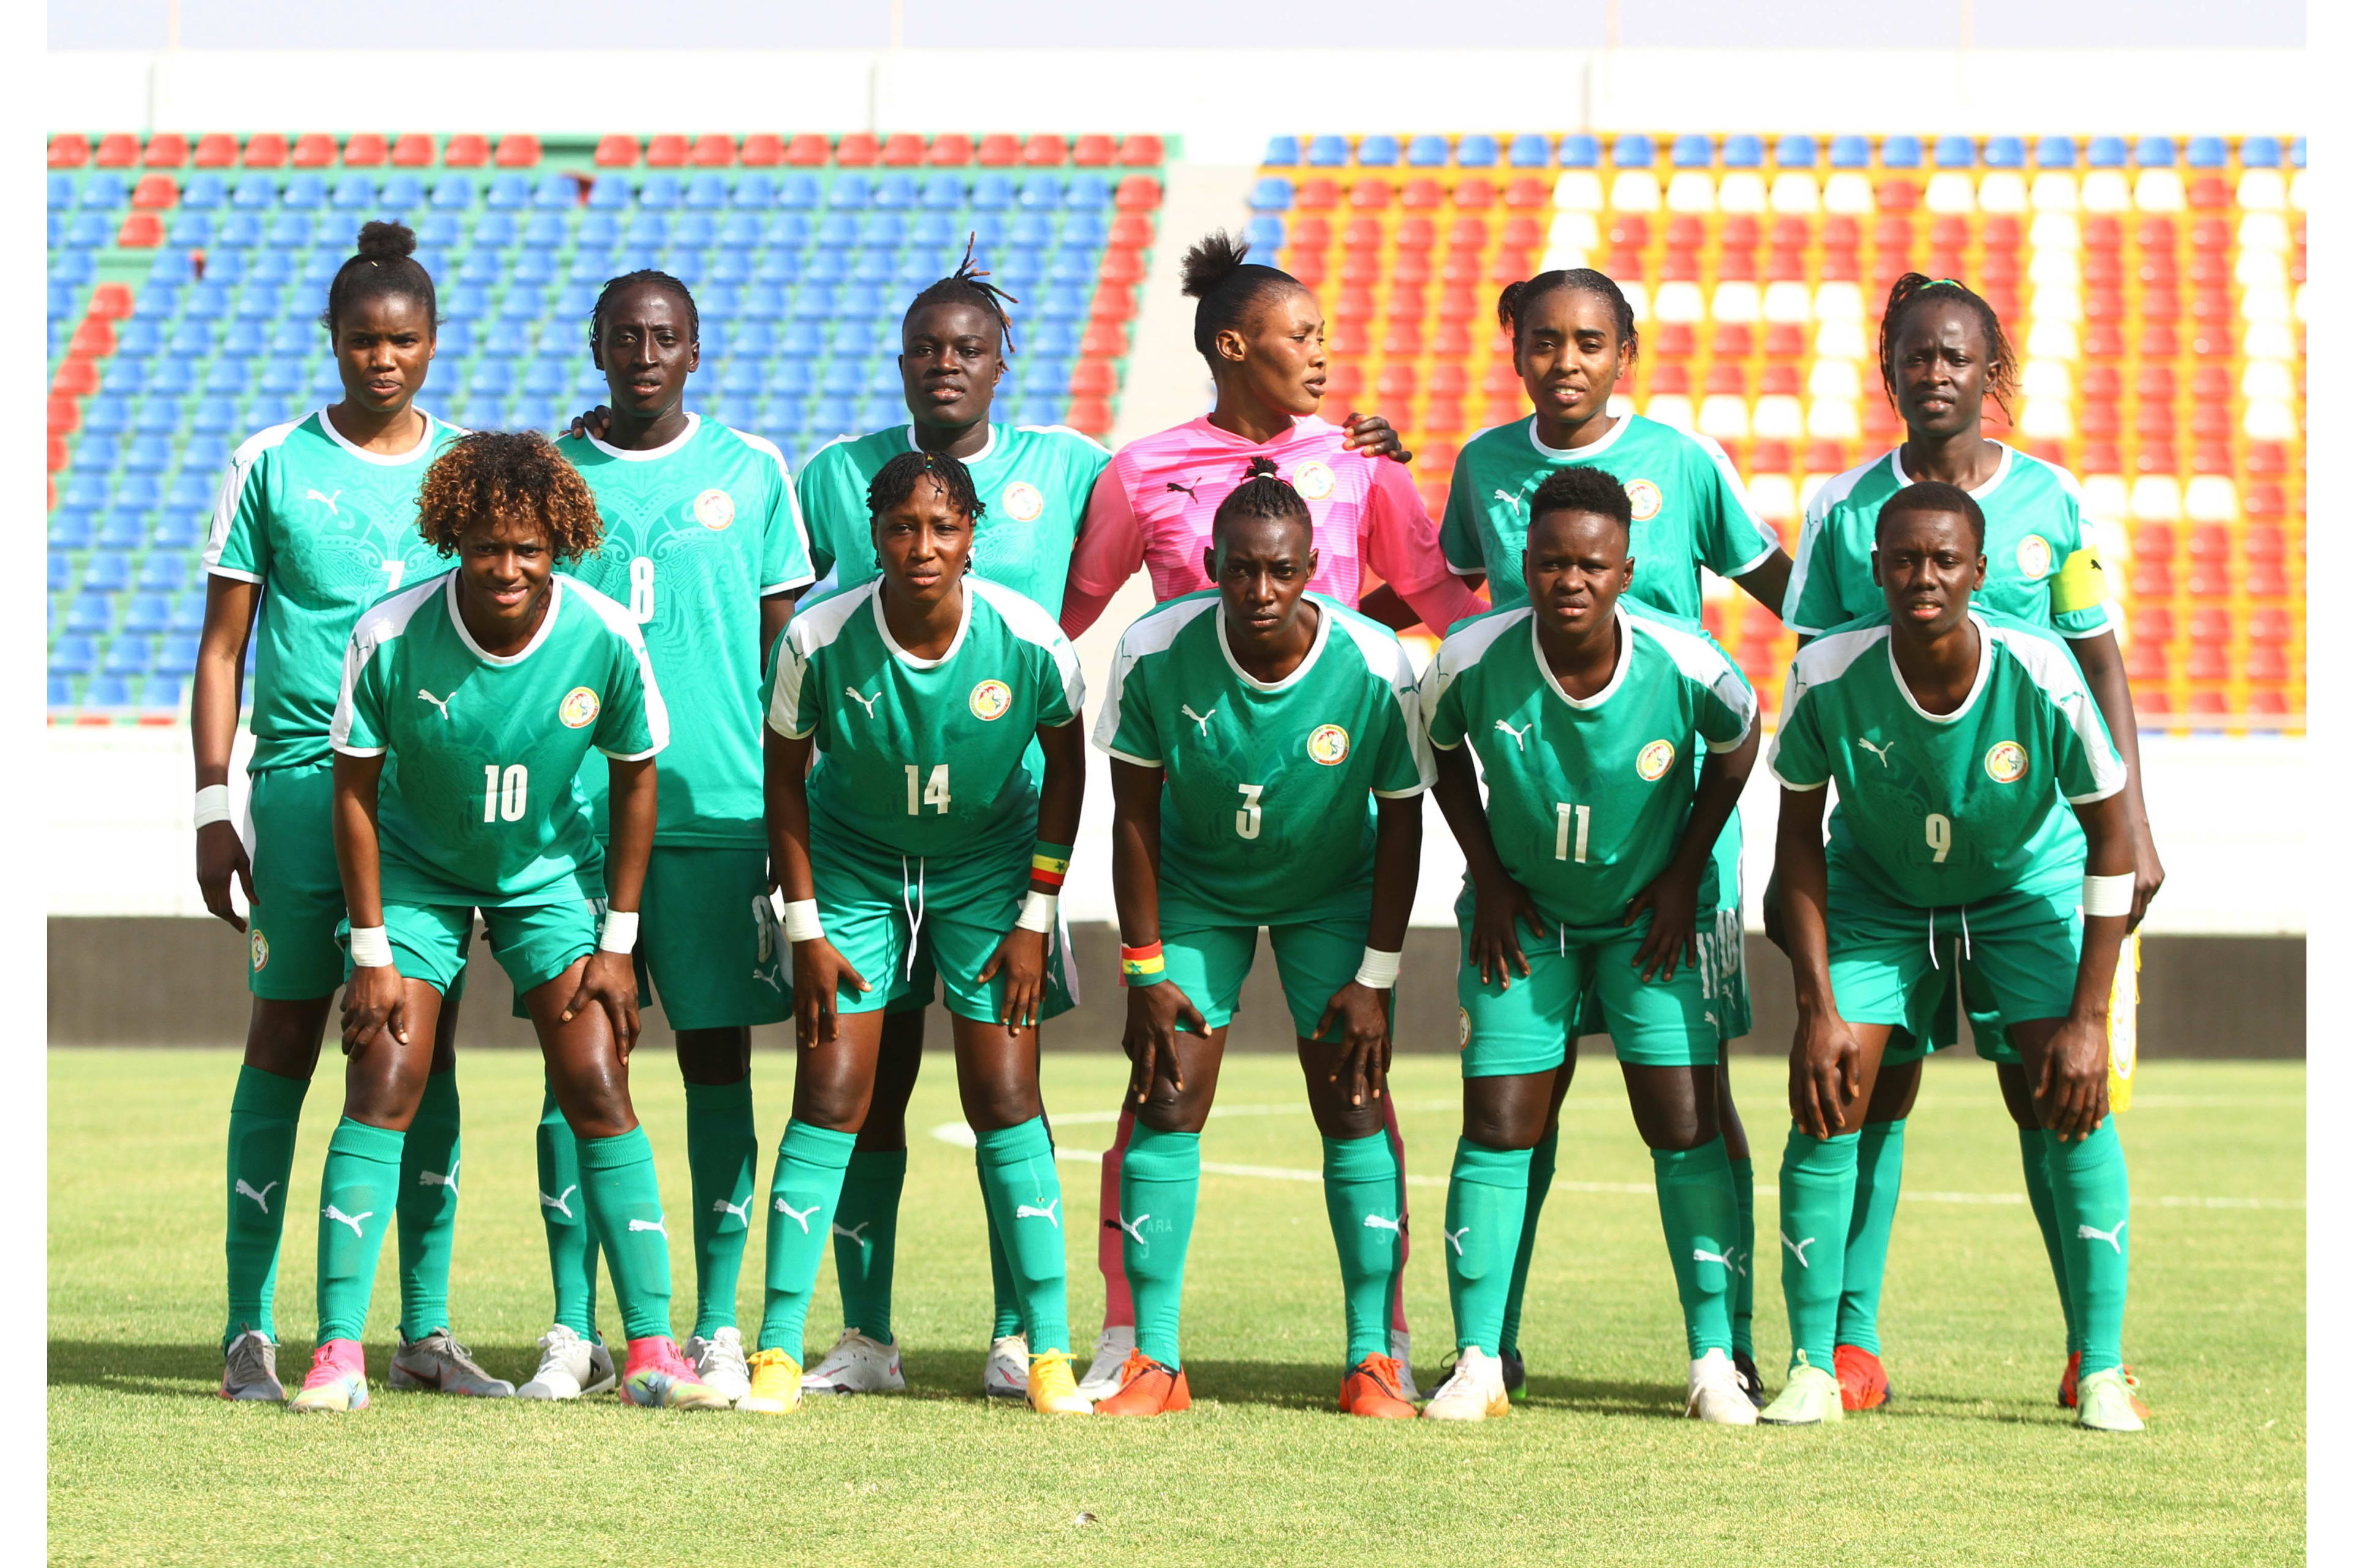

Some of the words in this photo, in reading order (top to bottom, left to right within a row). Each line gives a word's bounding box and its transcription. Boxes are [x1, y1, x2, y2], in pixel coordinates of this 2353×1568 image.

[381, 559, 406, 593] 7
[630, 556, 654, 624] 8
[484, 764, 528, 823] 10
[904, 764, 951, 816] 14
[1235, 784, 1264, 840] 3
[1555, 803, 1590, 862] 11
[1925, 814, 1951, 863] 9
[752, 895, 773, 963] 8
[1696, 932, 1718, 999] 11
